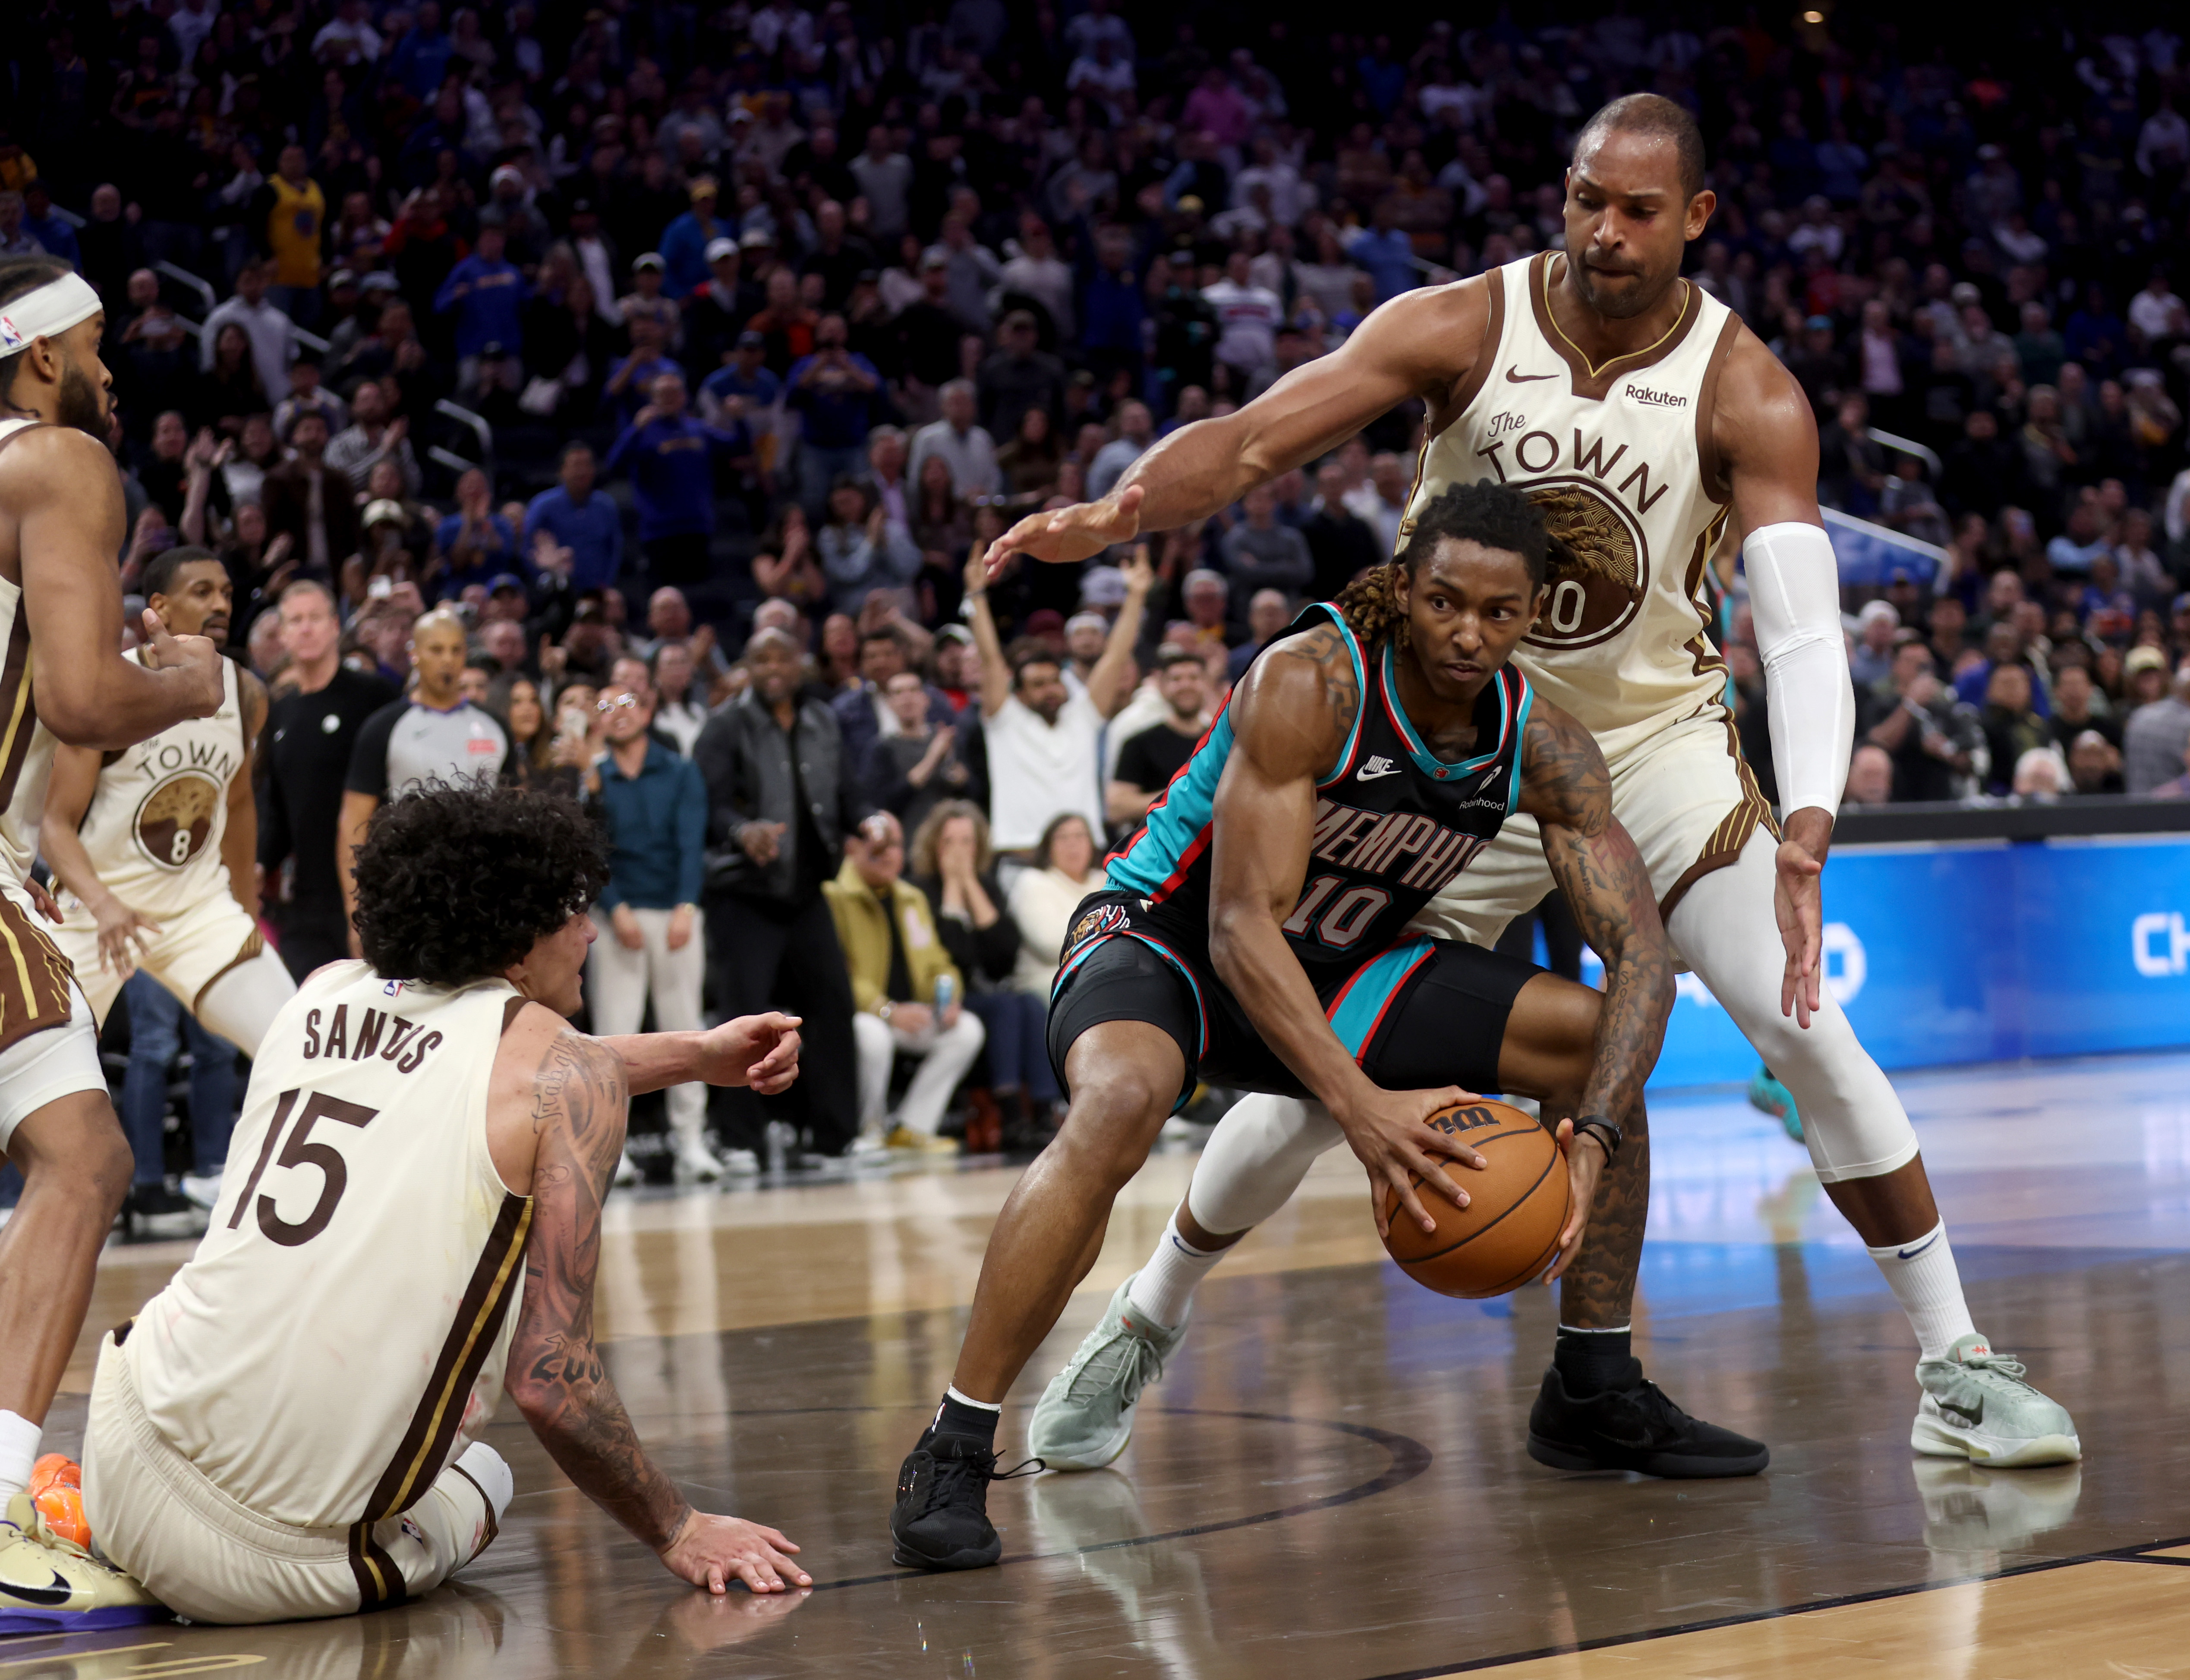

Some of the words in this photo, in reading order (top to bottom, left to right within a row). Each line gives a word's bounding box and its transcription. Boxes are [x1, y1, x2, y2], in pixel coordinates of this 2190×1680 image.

[1626, 384, 1687, 408] Rakuten
[1487, 411, 1526, 437] The
[1477, 428, 1669, 515] TOWN
[1536, 580, 1586, 633] 0
[135, 739, 236, 781] TOWN
[1364, 755, 1393, 774] NIKE
[1459, 797, 1505, 811] Robinhood
[170, 829, 192, 864] 8
[1282, 873, 1394, 951] 10
[227, 1087, 380, 1247] 15
